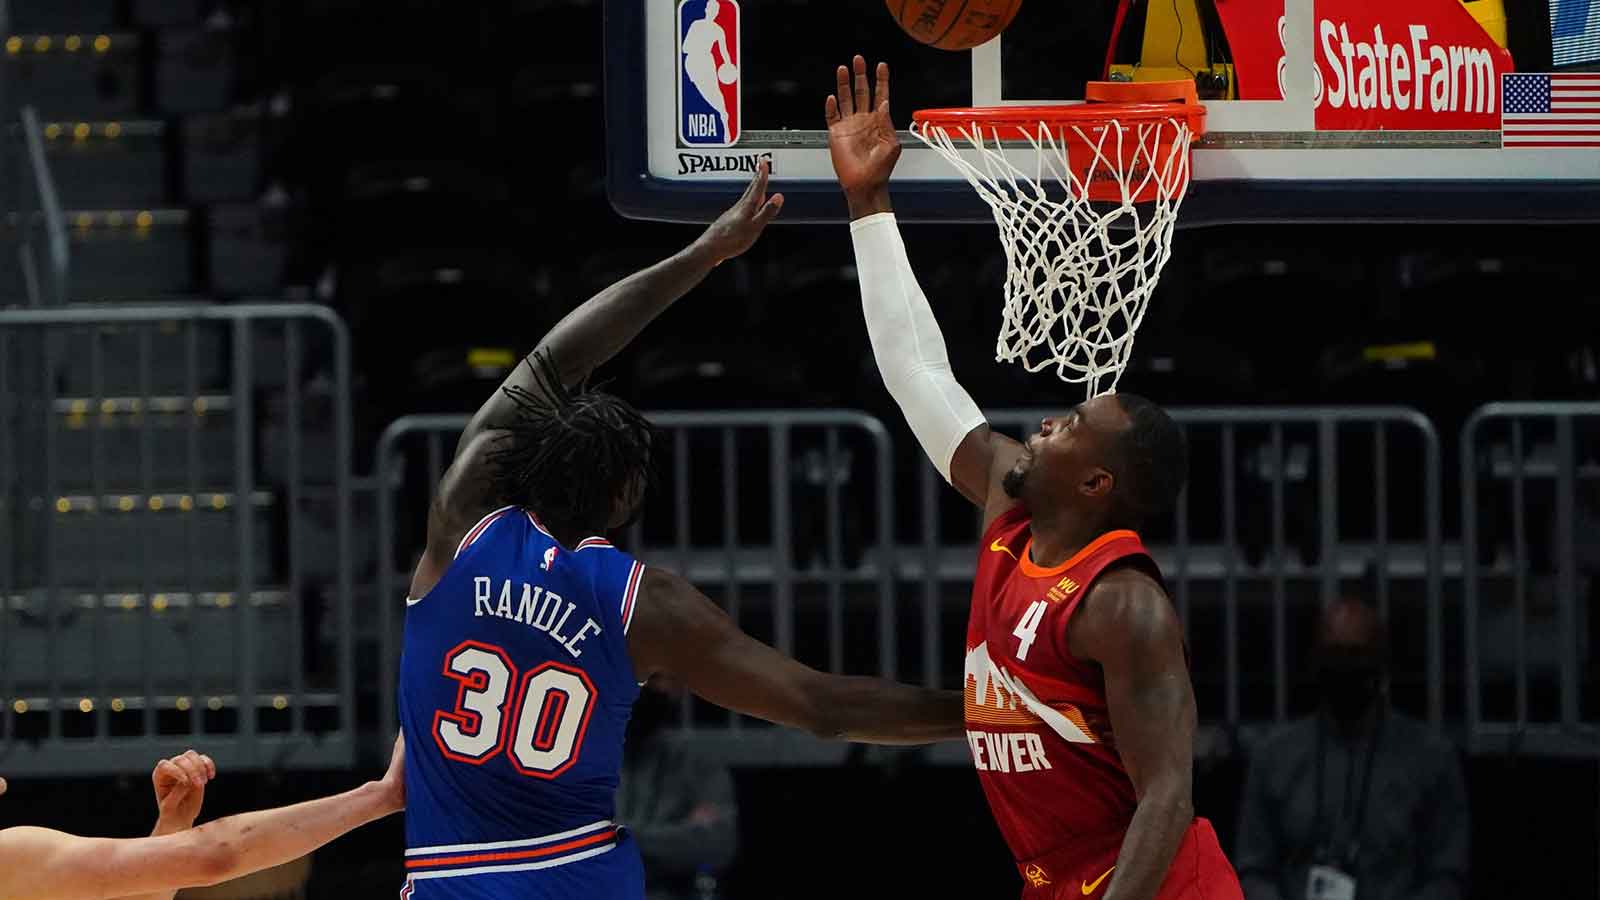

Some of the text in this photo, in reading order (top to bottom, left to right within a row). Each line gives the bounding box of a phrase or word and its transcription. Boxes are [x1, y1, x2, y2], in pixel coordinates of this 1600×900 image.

[688, 114, 717, 137] NBA
[1056, 576, 1080, 594] WU
[474, 576, 602, 658] RANDLE
[1012, 600, 1048, 662] 4
[432, 640, 598, 780] 30
[966, 729, 1052, 773] ENVER
